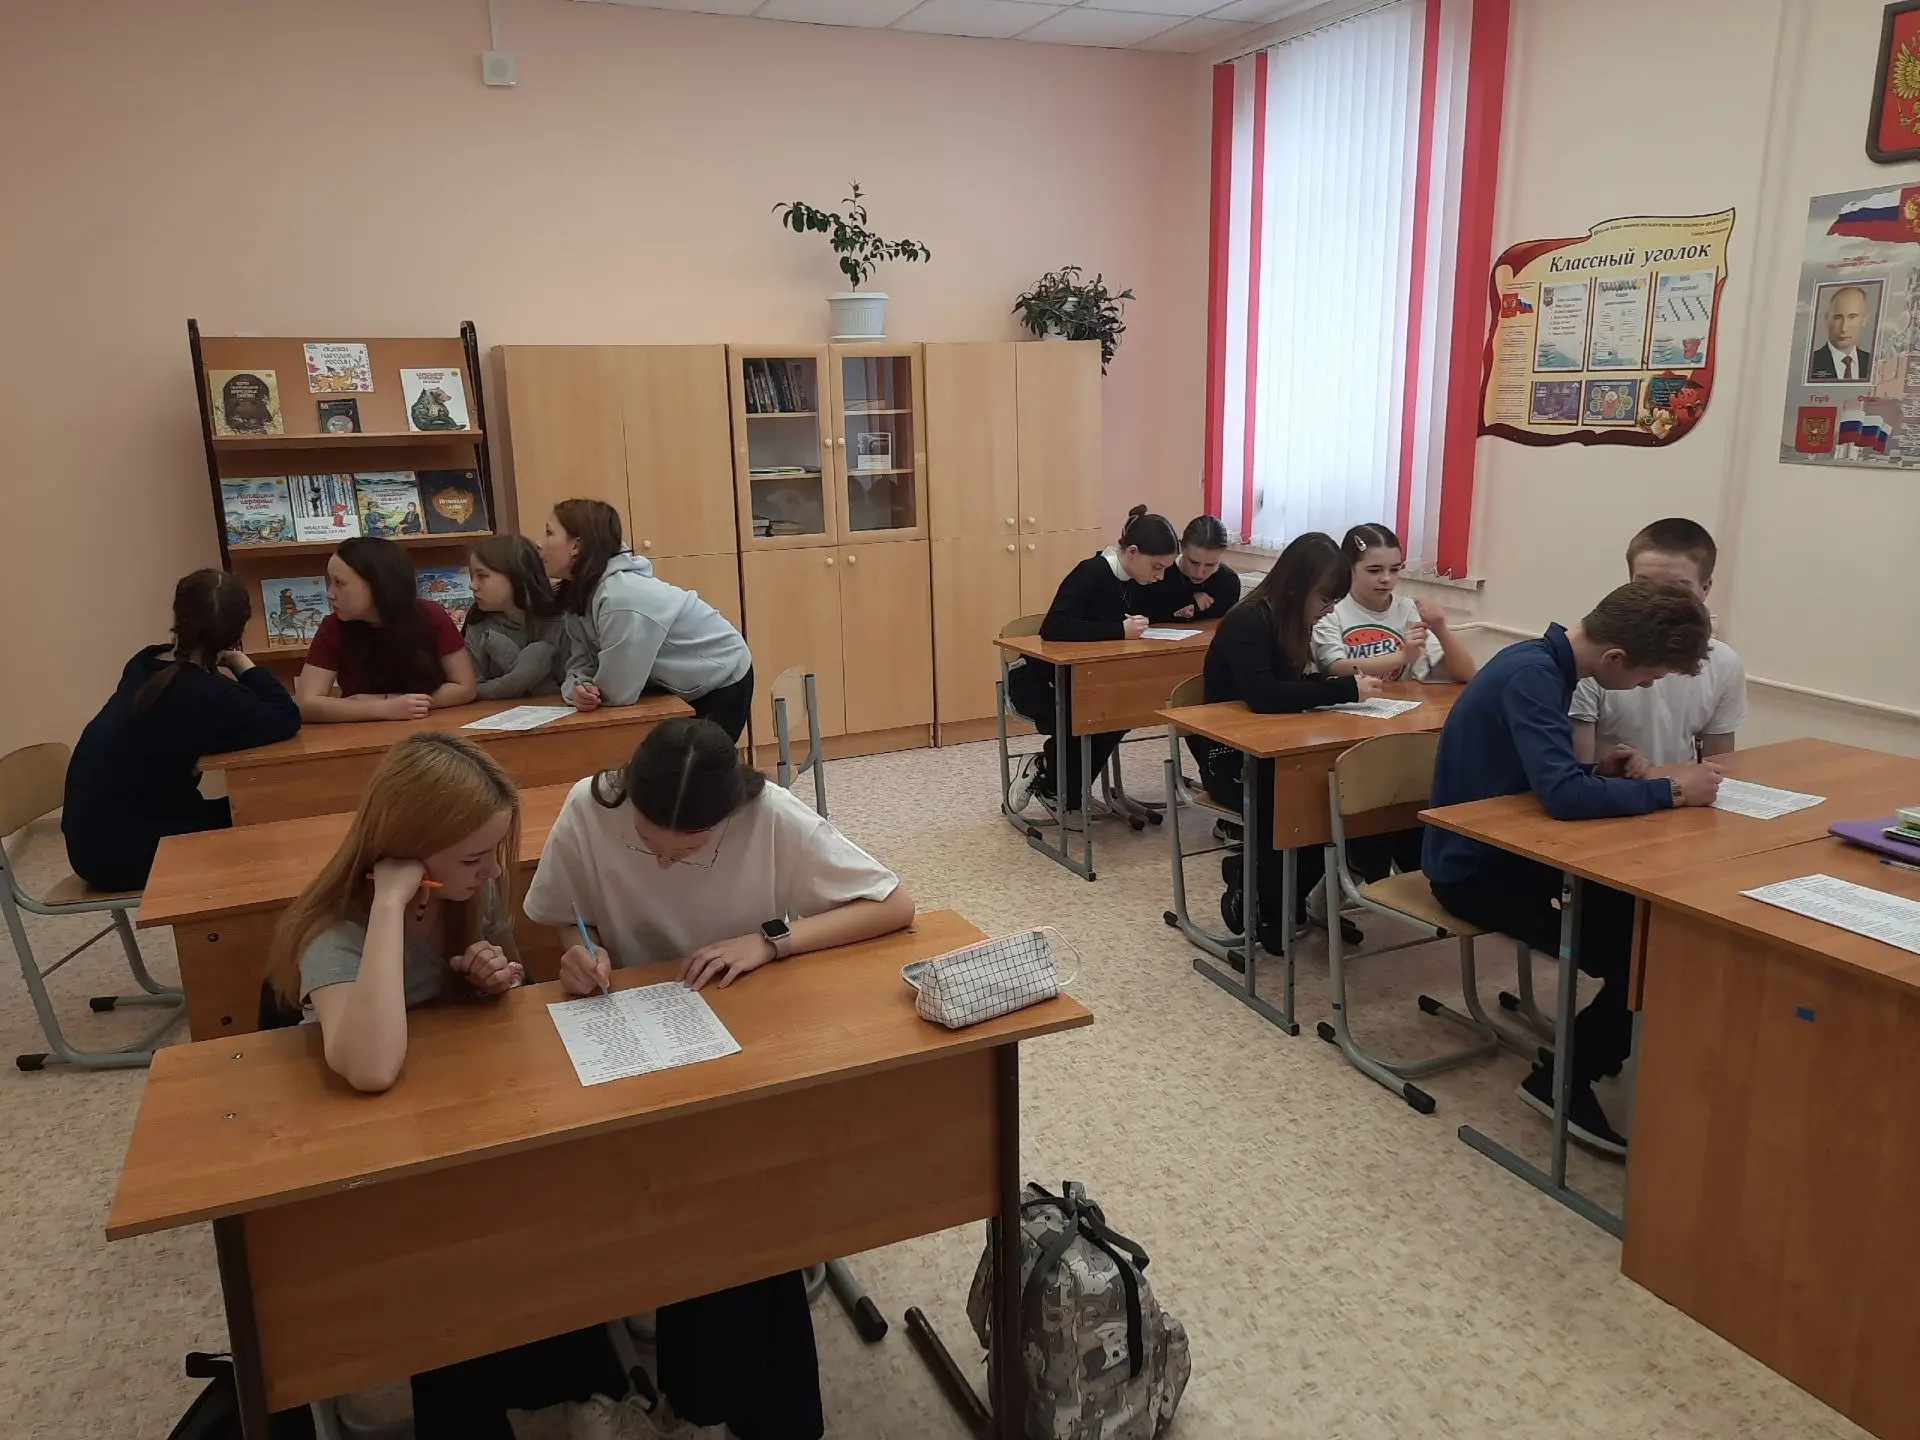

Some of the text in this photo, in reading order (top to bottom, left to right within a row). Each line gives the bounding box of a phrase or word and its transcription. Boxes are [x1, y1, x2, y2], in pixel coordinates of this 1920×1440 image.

[1549, 242, 1712, 273] Классный уголок
[1810, 394, 1830, 404] Герб
